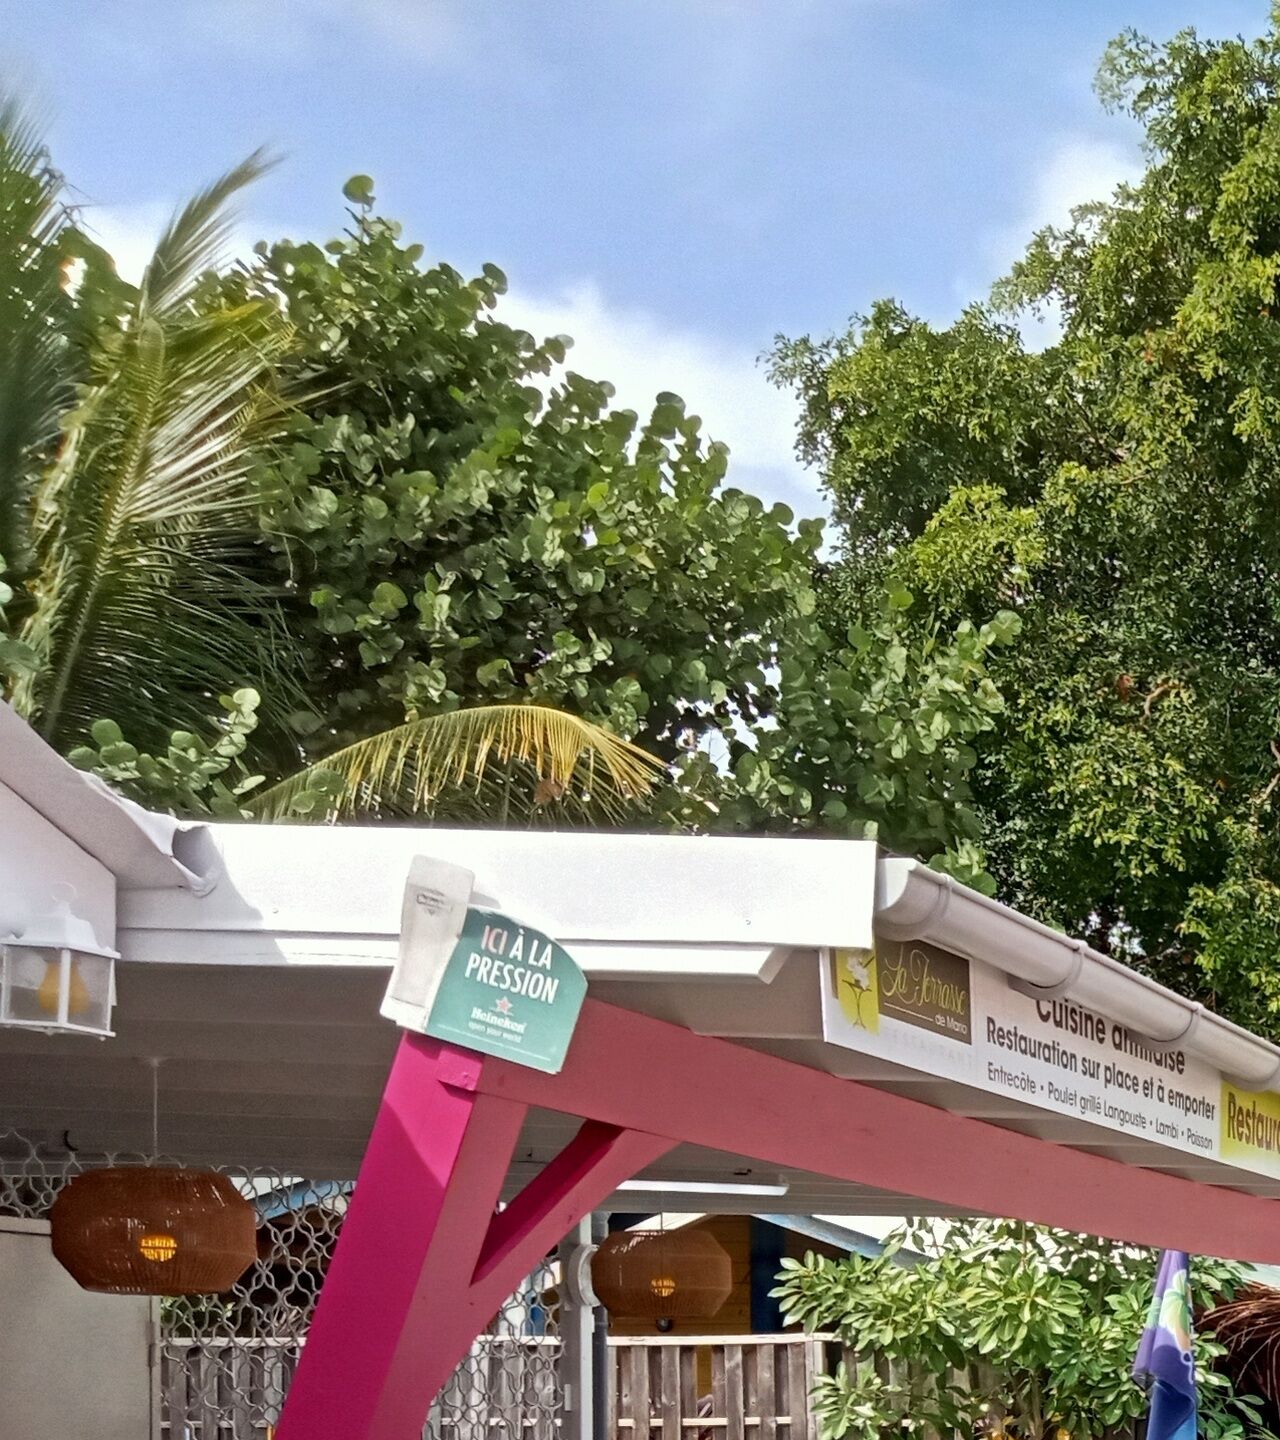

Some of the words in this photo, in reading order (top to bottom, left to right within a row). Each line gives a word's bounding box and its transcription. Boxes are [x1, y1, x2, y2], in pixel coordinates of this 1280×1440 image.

[481, 924, 508, 956] ICI
[509, 928, 526, 961] À
[528, 939, 553, 970] LA
[464, 952, 560, 1004] PRESSION
[910, 949, 966, 1015] Terrasse
[471, 1006, 527, 1034] Heineken
[1036, 999, 1107, 1045] Cuisine
[986, 1016, 1078, 1073] Restauration
[1081, 1056, 1101, 1080] sur
[1104, 1062, 1140, 1094] place
[1142, 1075, 1154, 1100] et
[1156, 1078, 1166, 1104] à
[1168, 1091, 1216, 1121] emporter
[988, 1062, 1037, 1094] Entrecôte
[1048, 1081, 1078, 1107] Poulet
[1079, 1093, 1102, 1115] grillé
[1104, 1102, 1147, 1129] Langouste
[1156, 1117, 1179, 1140] Lambi
[1187, 1127, 1214, 1151] Poisson
